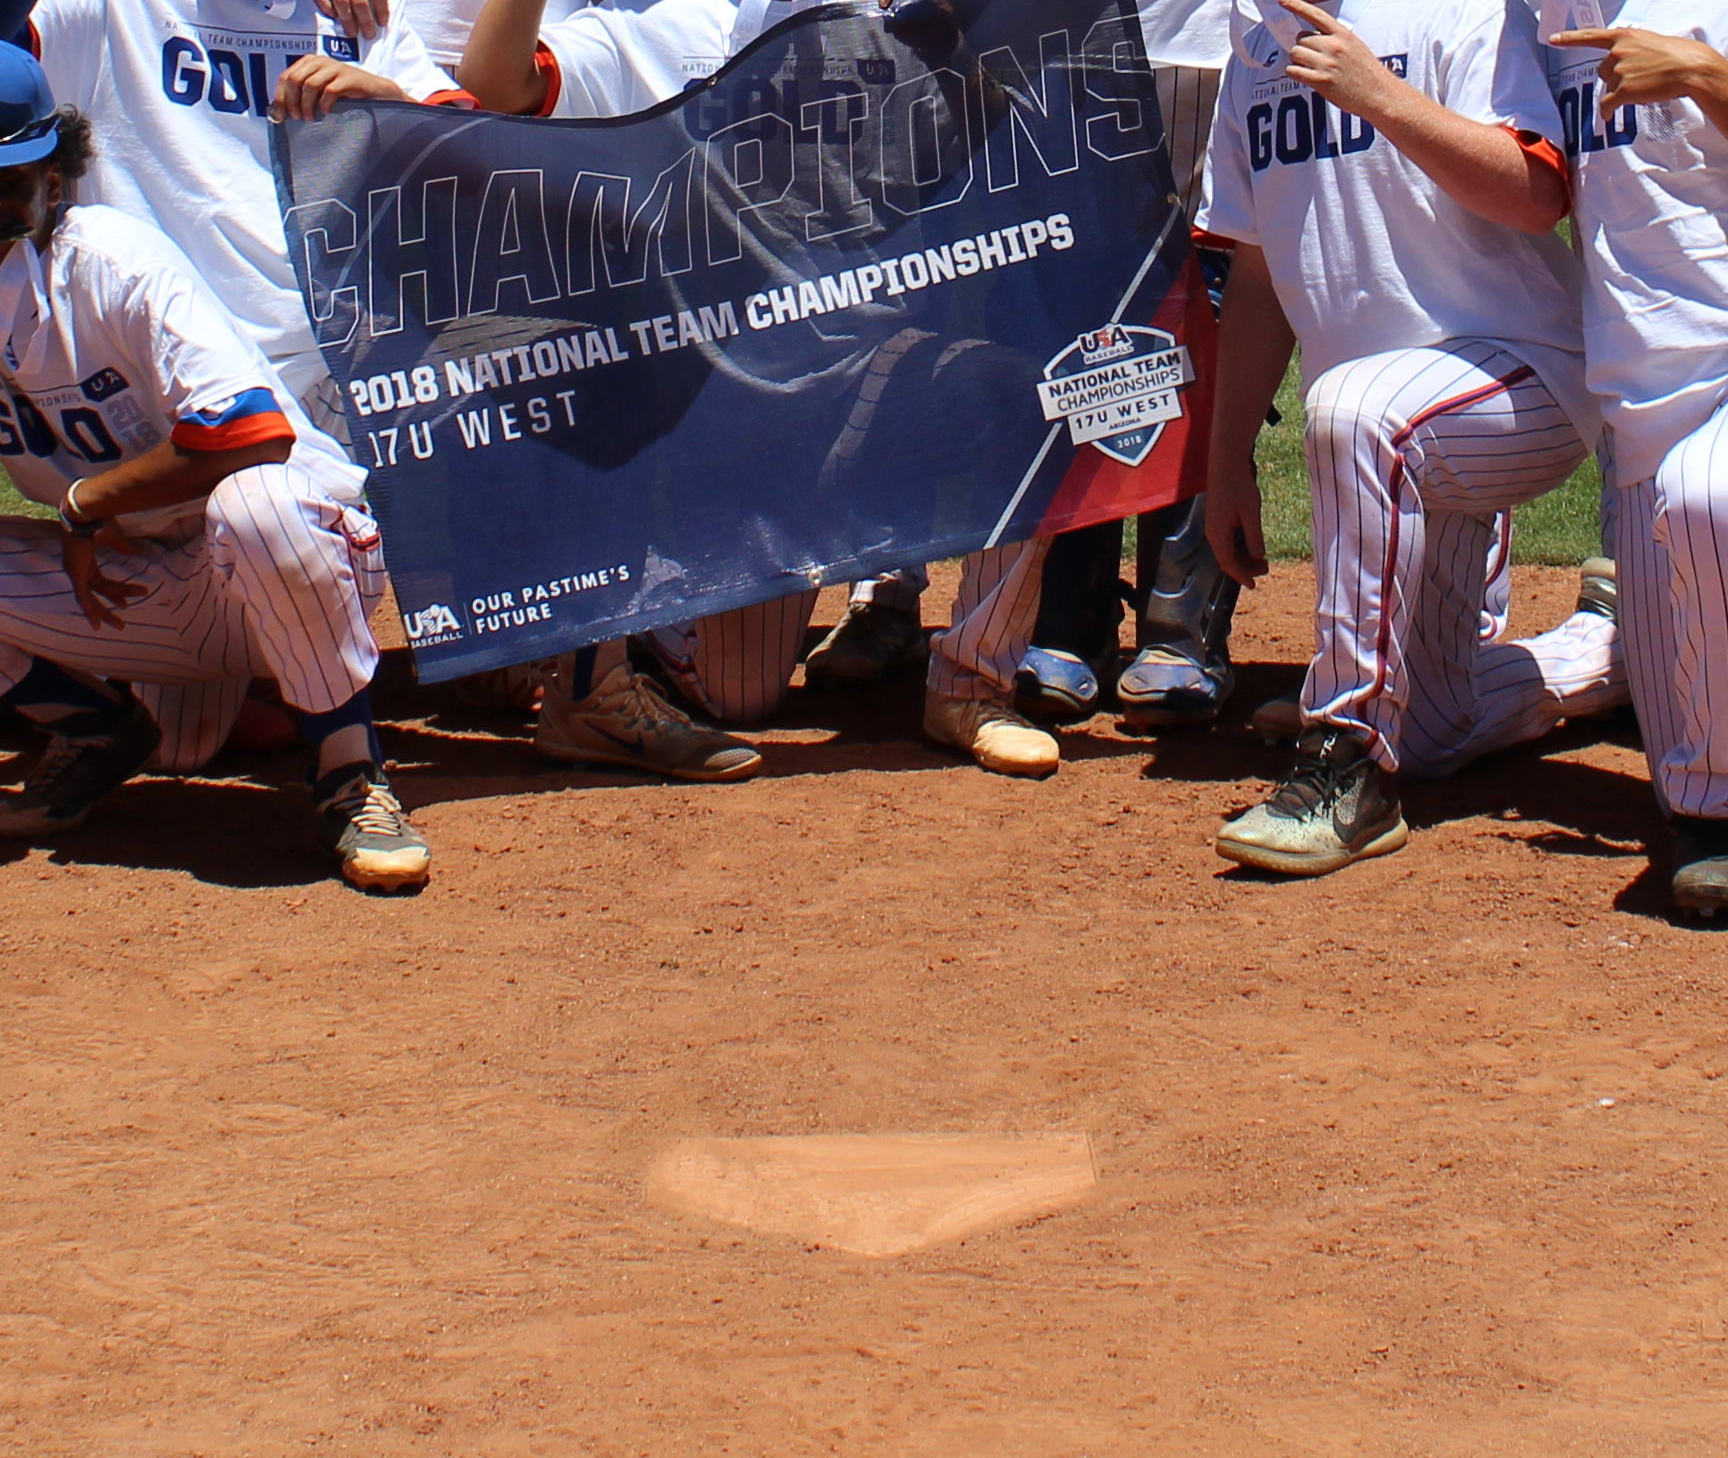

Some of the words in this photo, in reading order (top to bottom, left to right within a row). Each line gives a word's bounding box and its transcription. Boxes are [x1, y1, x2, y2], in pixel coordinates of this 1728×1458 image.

[208, 34, 234, 46] TEAM
[237, 38, 317, 51] CHAMPIONSHIPS
[162, 35, 306, 118] GOL
[1246, 91, 1376, 172] GOLD
[284, 14, 1167, 346] CHAMPIONS
[350, 365, 440, 416] 2018
[444, 327, 629, 398] NATIONAL
[629, 300, 740, 357] TEAM
[746, 213, 1075, 331] CHAMPIONSHIPS
[1080, 326, 1130, 354] USA
[1085, 346, 1134, 363] BASEBALL
[1048, 367, 1130, 399] NATIONAL
[1134, 351, 1182, 375] TEAM
[1057, 368, 1181, 412] CHAMPIONSHIPS
[368, 420, 435, 470] 17U
[456, 390, 577, 450] WEST
[1075, 411, 1109, 430] 17U
[1117, 394, 1171, 418] WEST
[1108, 417, 1143, 431] ARIZONA
[1116, 434, 1143, 450] 2018
[472, 591, 515, 615] OUR
[521, 564, 631, 604] PASTIME'S
[403, 604, 461, 639] USA
[474, 602, 553, 635] FUTURE
